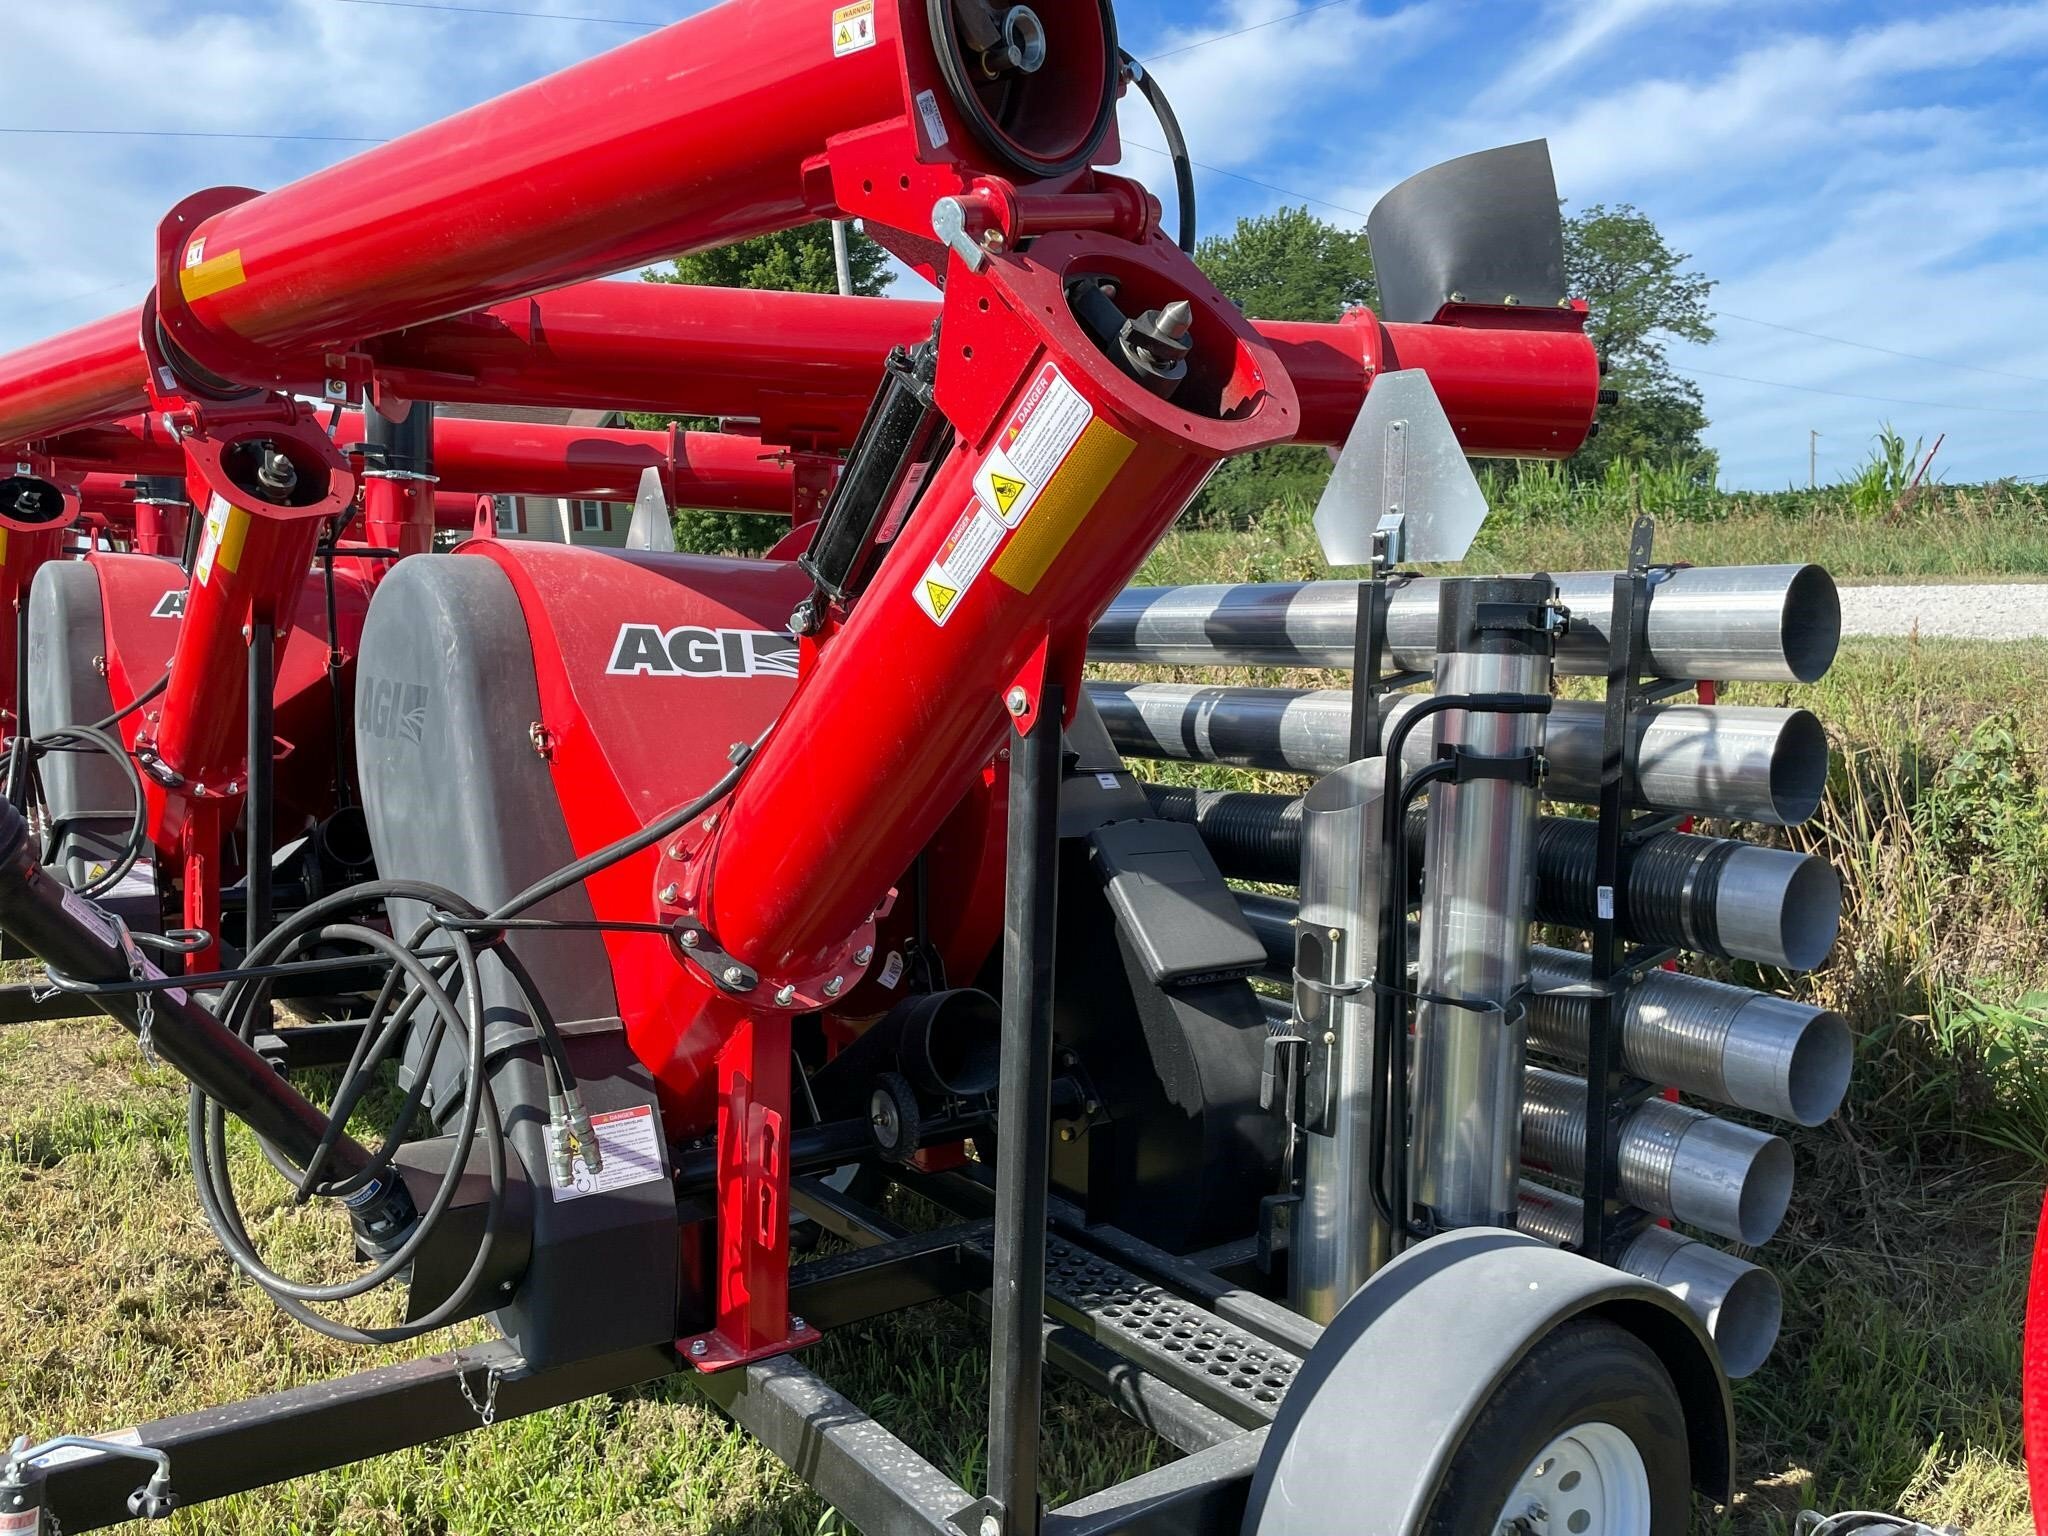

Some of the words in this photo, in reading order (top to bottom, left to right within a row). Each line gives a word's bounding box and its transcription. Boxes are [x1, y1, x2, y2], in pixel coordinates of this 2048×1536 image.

[843, 3, 871, 18] WARNING
[1016, 376, 1048, 424] DANGER
[947, 532, 970, 565] ELECTROCUTION
[968, 515, 980, 533] HAZARD
[951, 515, 970, 543] DANGER
[607, 625, 750, 676] AGI
[359, 676, 402, 738] AGI
[609, 1111, 634, 1120] DANGER
[350, 1189, 373, 1204] NOTICE
